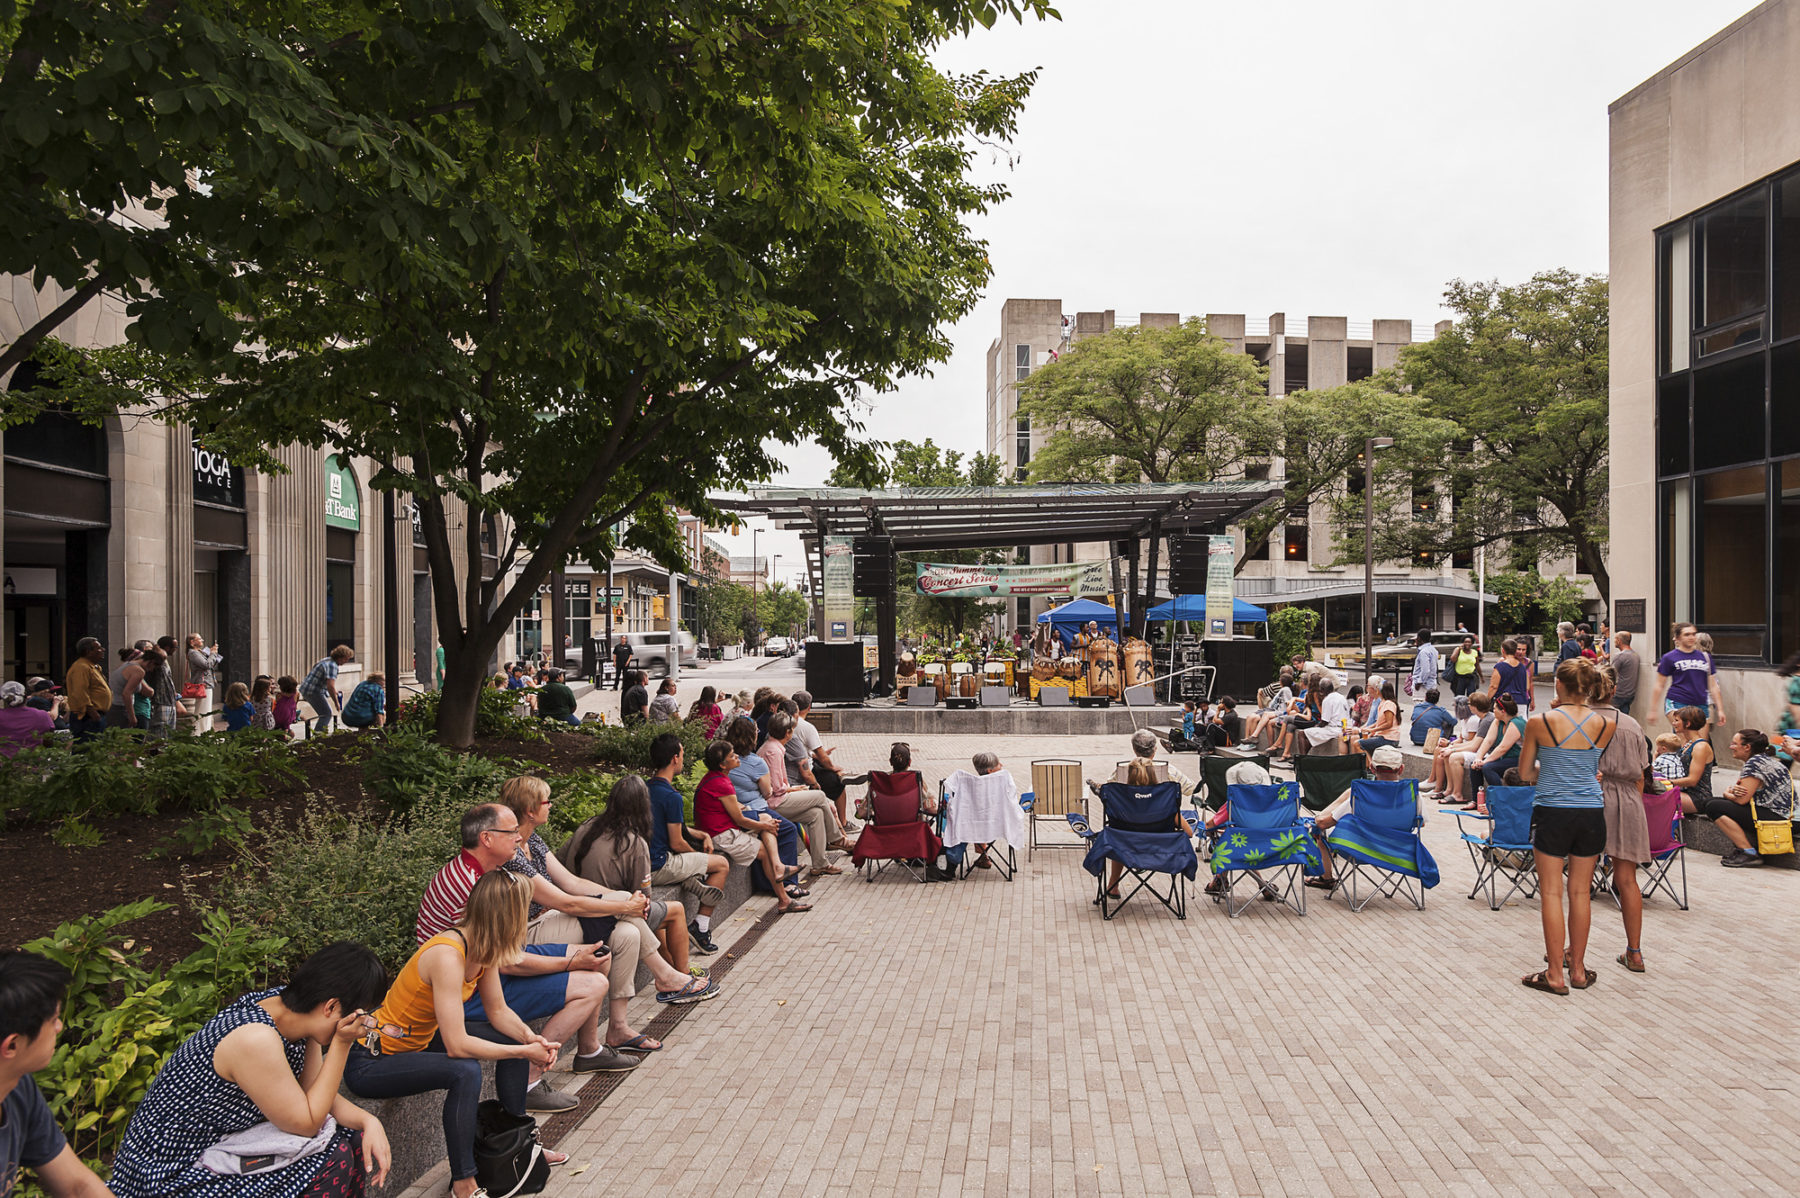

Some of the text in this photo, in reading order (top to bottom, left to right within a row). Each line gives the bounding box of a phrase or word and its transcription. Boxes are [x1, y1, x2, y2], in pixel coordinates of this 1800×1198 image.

[198, 472, 231, 489] LACE
[334, 500, 357, 521] Bank
[950, 566, 986, 575] Summer
[1083, 565, 1103, 574] Free
[922, 573, 1000, 589] Concert Series
[537, 584, 588, 594] COFEE
[1080, 584, 1106, 593] Music
